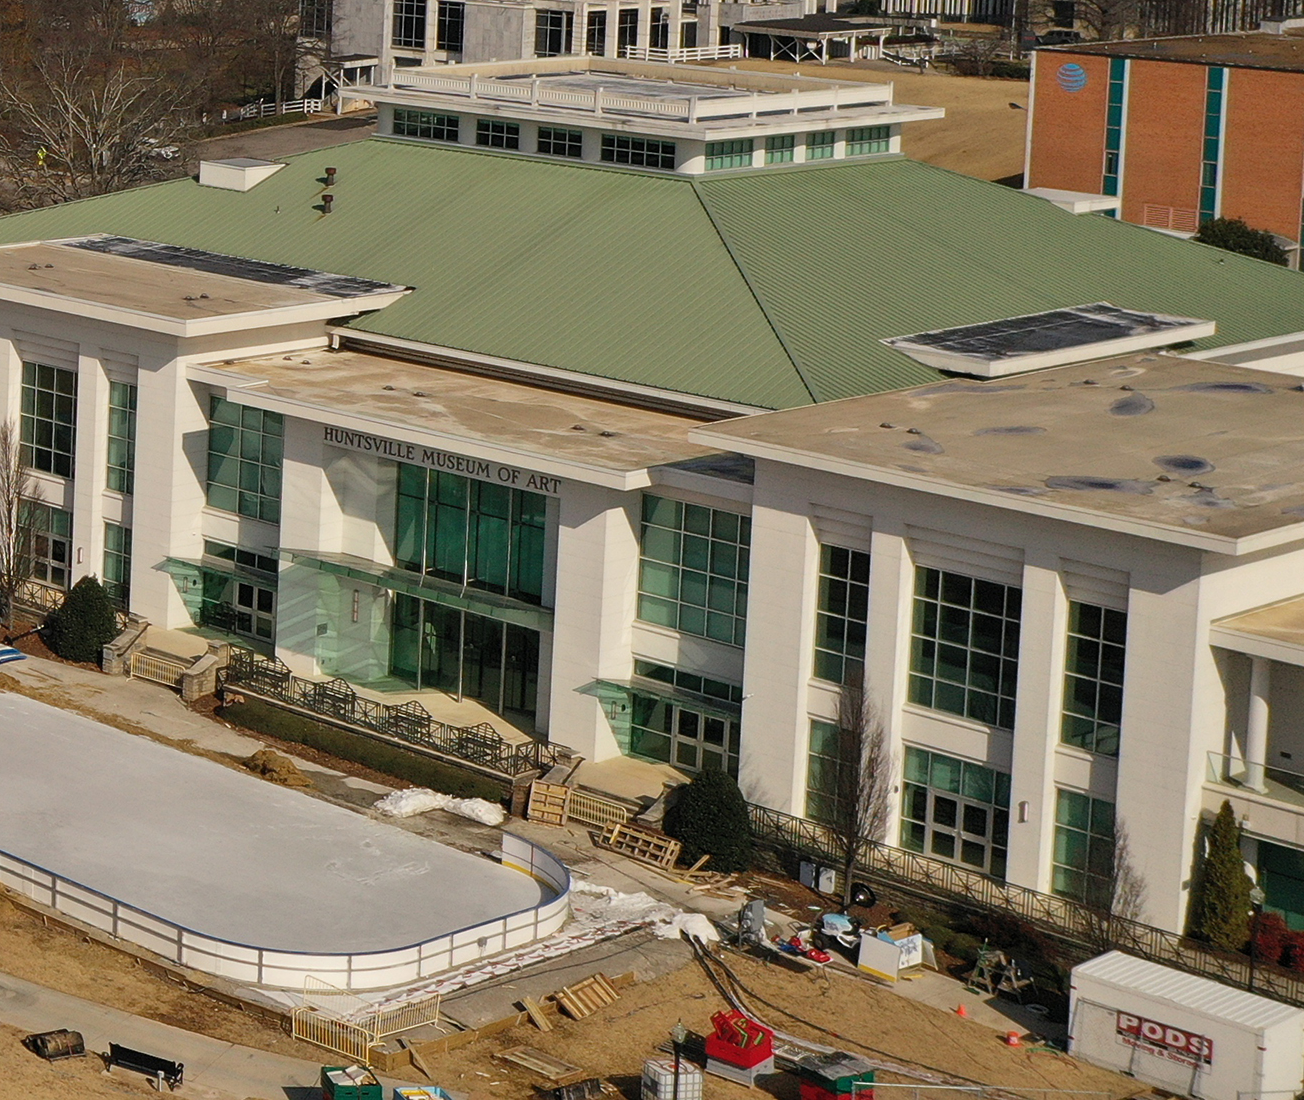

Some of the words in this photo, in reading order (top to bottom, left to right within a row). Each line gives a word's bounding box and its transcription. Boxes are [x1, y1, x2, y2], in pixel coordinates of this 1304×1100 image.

[323, 426, 415, 461] HUNTSVILLE
[421, 448, 491, 478] MUSEUM
[497, 466, 521, 485] OF
[526, 474, 562, 494] ART
[1118, 1012, 1210, 1056] PODS
[1157, 1048, 1165, 1057] &
